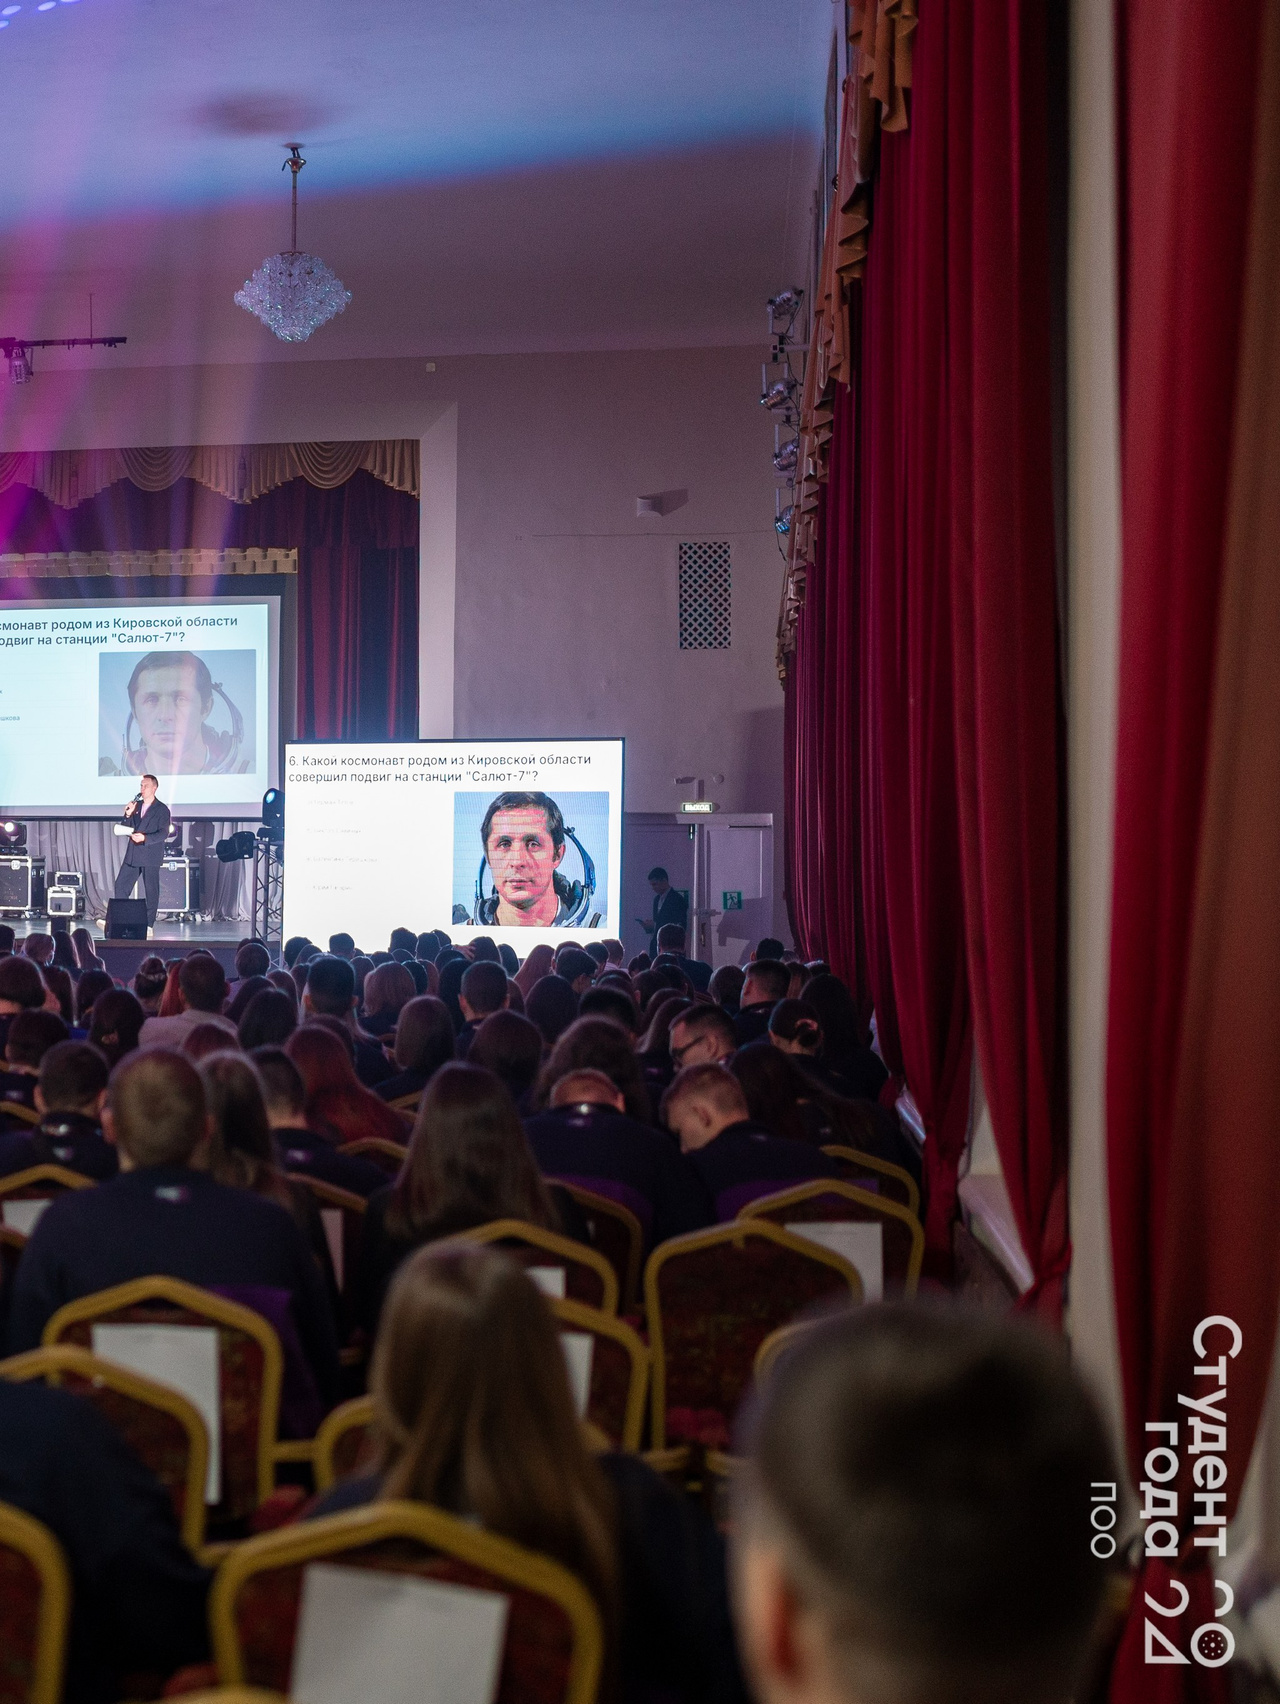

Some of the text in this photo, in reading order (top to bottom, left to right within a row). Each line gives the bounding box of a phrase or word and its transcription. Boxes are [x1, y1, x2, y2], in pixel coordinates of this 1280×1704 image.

[51, 620, 93, 632] родом
[96, 620, 110, 630] из
[113, 616, 182, 630] Кировской
[186, 615, 238, 627] области
[37, 636, 52, 646] на
[55, 634, 108, 646] станции
[111, 632, 186, 645] "Салют-7"?
[289, 754, 592, 768] 6. Какой космонавт родом из Кировской области
[289, 770, 539, 785] совершил подвиг на станции "Салют-7"?
